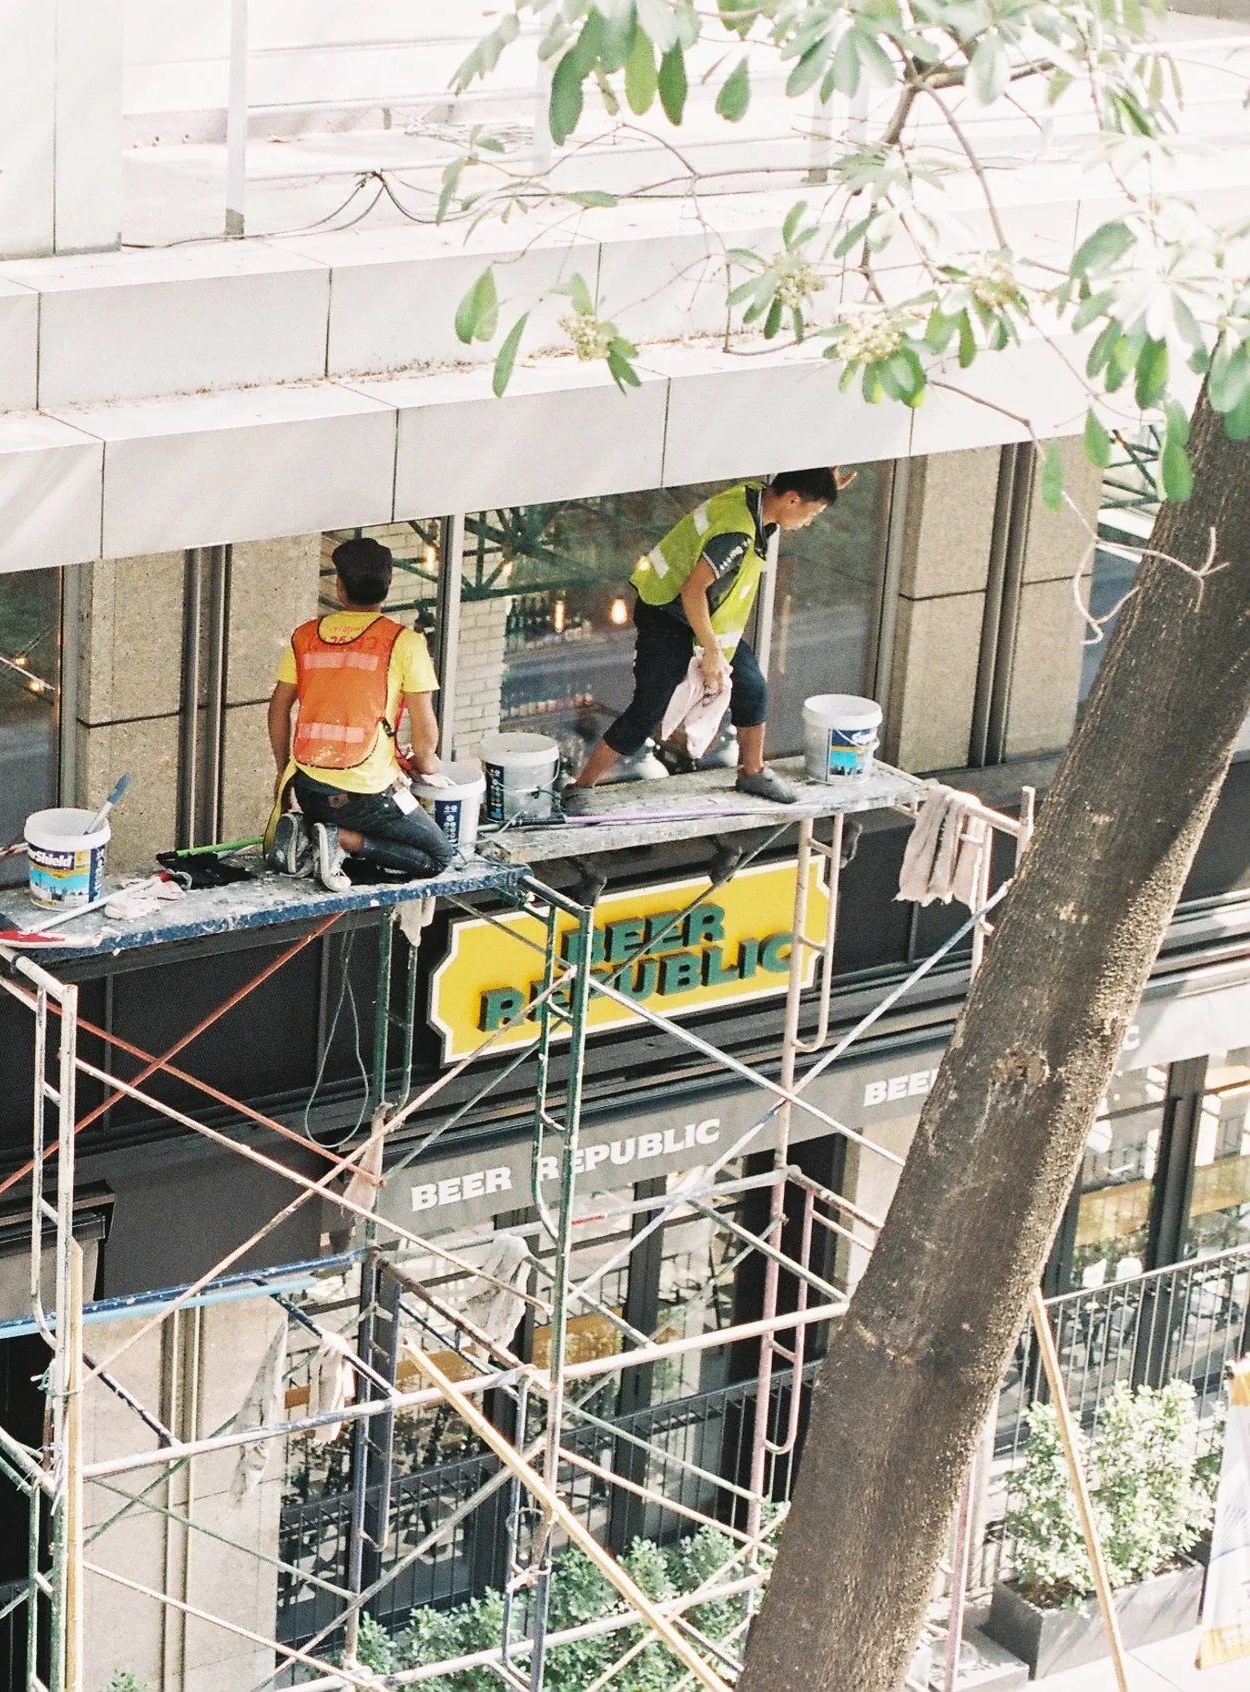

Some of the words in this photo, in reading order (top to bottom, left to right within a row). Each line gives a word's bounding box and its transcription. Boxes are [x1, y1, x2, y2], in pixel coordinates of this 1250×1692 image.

[558, 904, 726, 968] BEER
[863, 1067, 940, 1107] BEE
[411, 1167, 512, 1211] BEER
